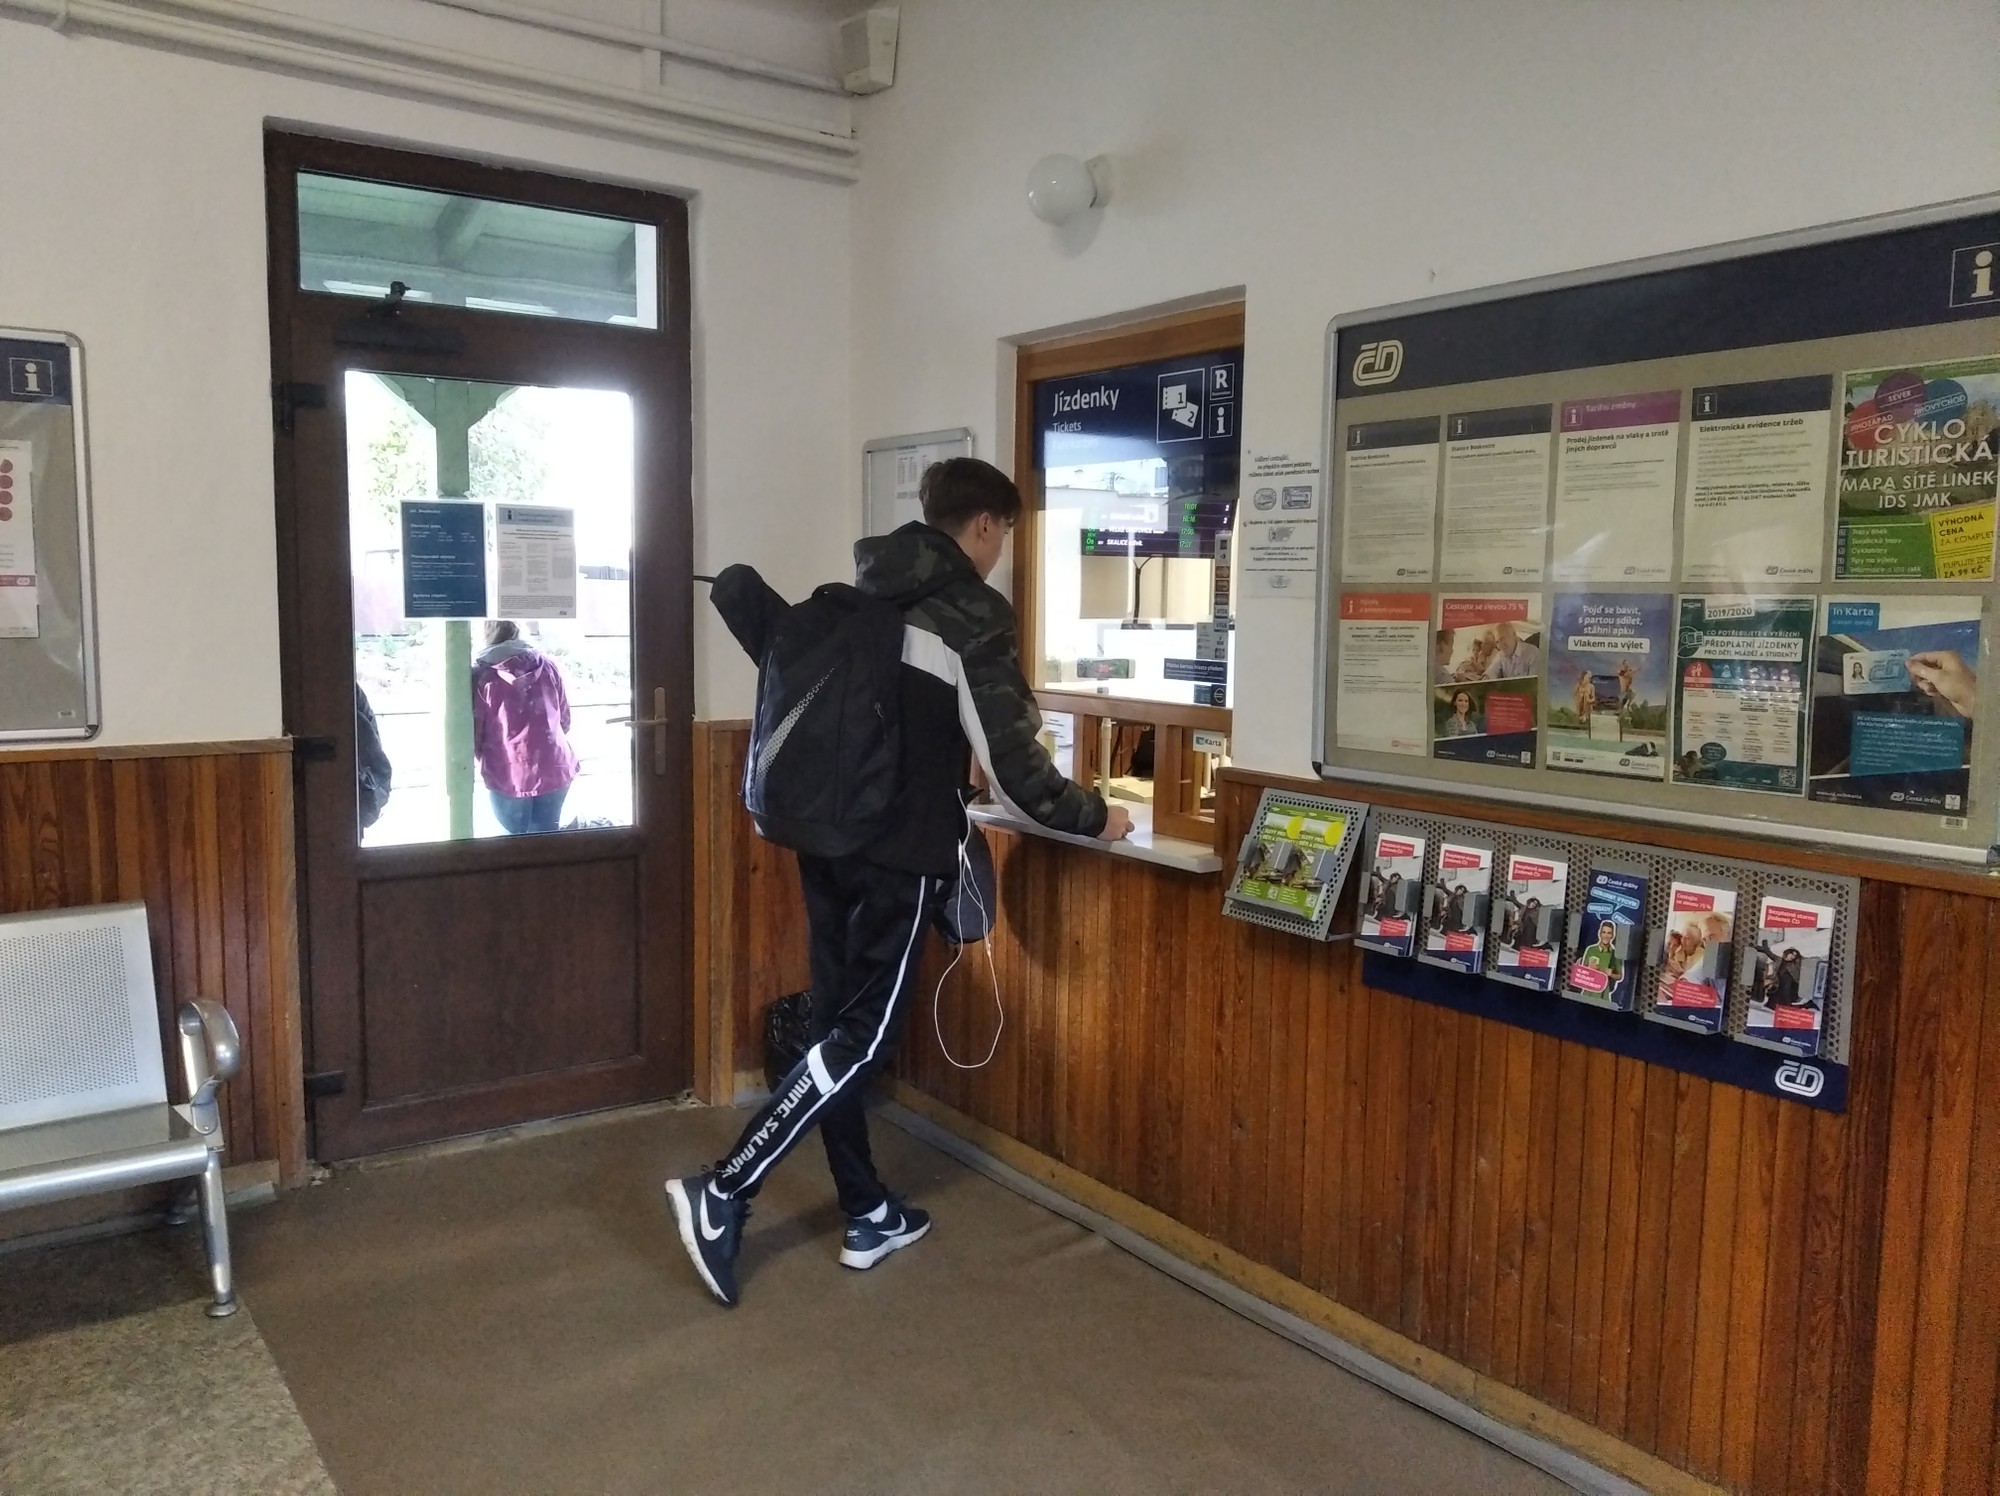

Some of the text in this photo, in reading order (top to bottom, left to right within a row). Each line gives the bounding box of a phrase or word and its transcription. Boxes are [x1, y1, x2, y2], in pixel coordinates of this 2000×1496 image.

[1215, 369, 1228, 389] R
[1053, 385, 1120, 417] Jízdenky
[1888, 390, 1912, 401] SEVER
[1913, 394, 1967, 416] JIHOVÝCHOD
[1052, 421, 1082, 433] Tickets
[1700, 418, 1804, 433] Elektronická evidence tržeb
[1850, 413, 1893, 432] JIHOZÁPAD
[1566, 436, 1587, 444] Prodej
[1587, 434, 1614, 444] jízdenek
[1626, 432, 1644, 440] vlaky
[1651, 429, 1669, 437] tratě
[1874, 418, 1966, 444] CYKLO
[1566, 442, 1617, 454] jiných dopravců
[1846, 434, 1994, 469] TURISTICKÁ
[1842, 471, 1995, 491] MAPA SÍTĚ LINEK
[1879, 492, 1952, 509] IDS JMK
[1938, 512, 1985, 528] VÝHODNÁ
[1939, 528, 1964, 537] CENA
[1954, 530, 1995, 544] KOMPLET
[1957, 569, 1968, 577] 99
[1971, 566, 1984, 574] KČ
[1445, 602, 1474, 612] Cestujte
[1484, 602, 1506, 610] slevou
[1508, 602, 1518, 610] 75
[1582, 605, 1603, 616] Pojď
[1616, 606, 1642, 616] bavit,
[1708, 607, 1753, 618] 2019/2020
[1833, 607, 1874, 616] In Karta
[1584, 616, 1614, 626] partou
[1616, 616, 1643, 626] sdílet,
[1584, 626, 1635, 637] stáhni apku
[1769, 629, 1800, 638] VYŘÍZENÍ
[1574, 639, 1644, 650] Vlakem na výlet
[1705, 638, 1799, 650] PŘEDPLATNÍ JÍZDENKY
[1205, 738, 1222, 746] Karta
[1607, 878, 1639, 890] České dráhy
[1767, 914, 1791, 923] jízdenek
[1768, 908, 1816, 921] Bezplatné storno
